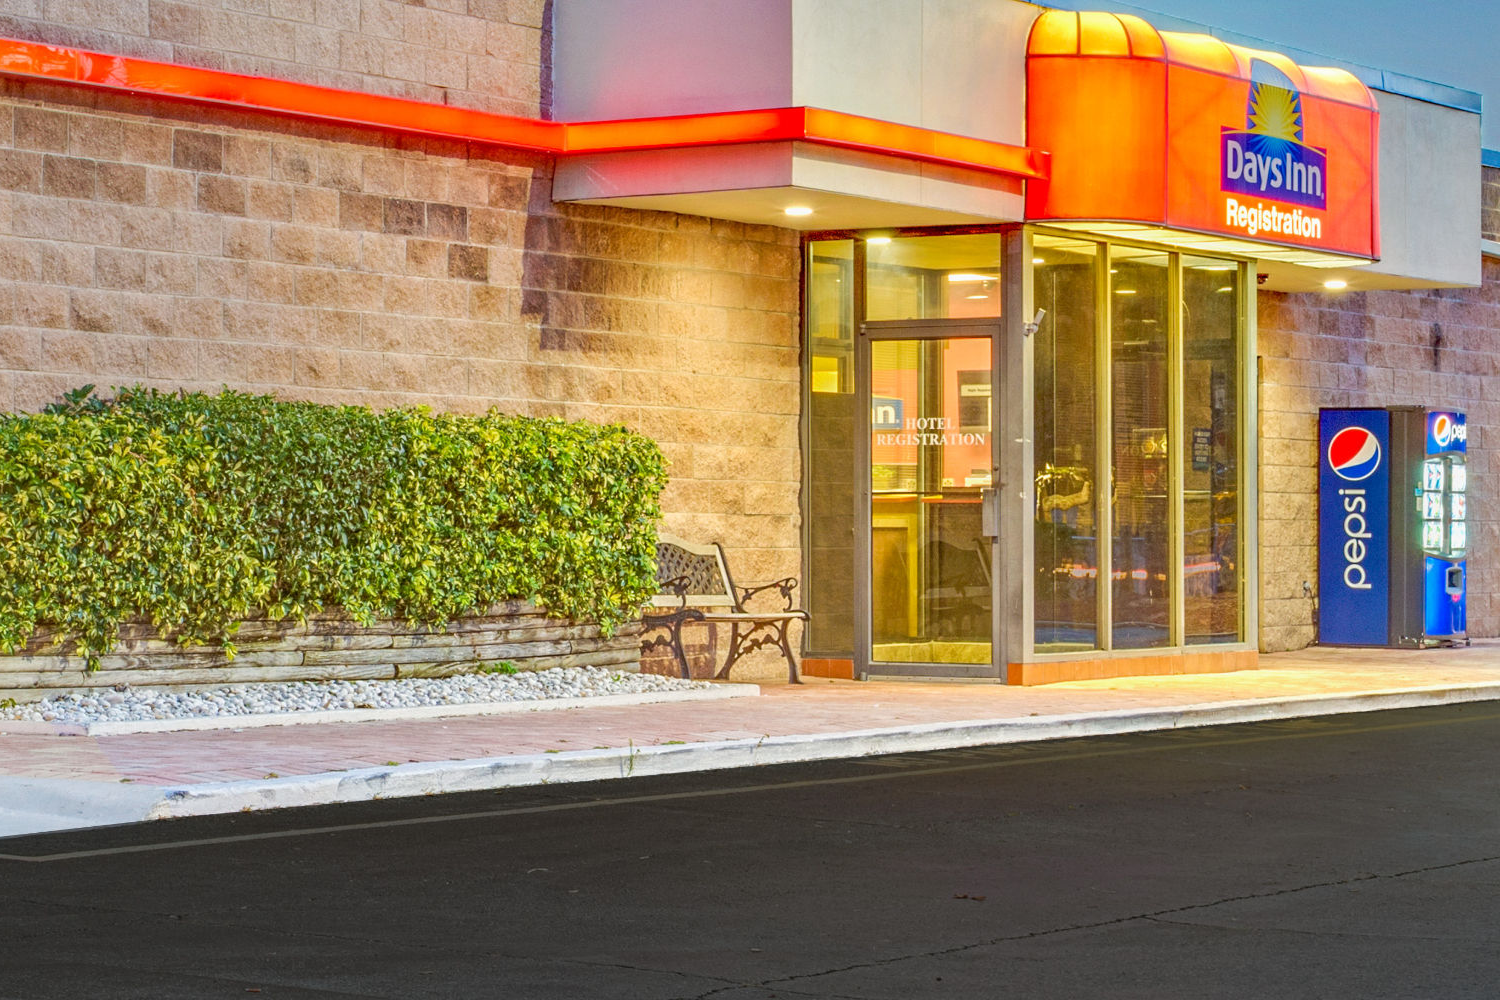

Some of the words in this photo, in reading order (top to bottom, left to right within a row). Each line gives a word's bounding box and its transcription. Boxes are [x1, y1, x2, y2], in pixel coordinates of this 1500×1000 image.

[1227, 139, 1283, 191] Days
[1286, 152, 1322, 197] Inn
[1226, 198, 1321, 239] Registration
[877, 432, 985, 446] REGISTRATION
[906, 417, 956, 430] HOTEL
[1338, 488, 1372, 589] pepsi
